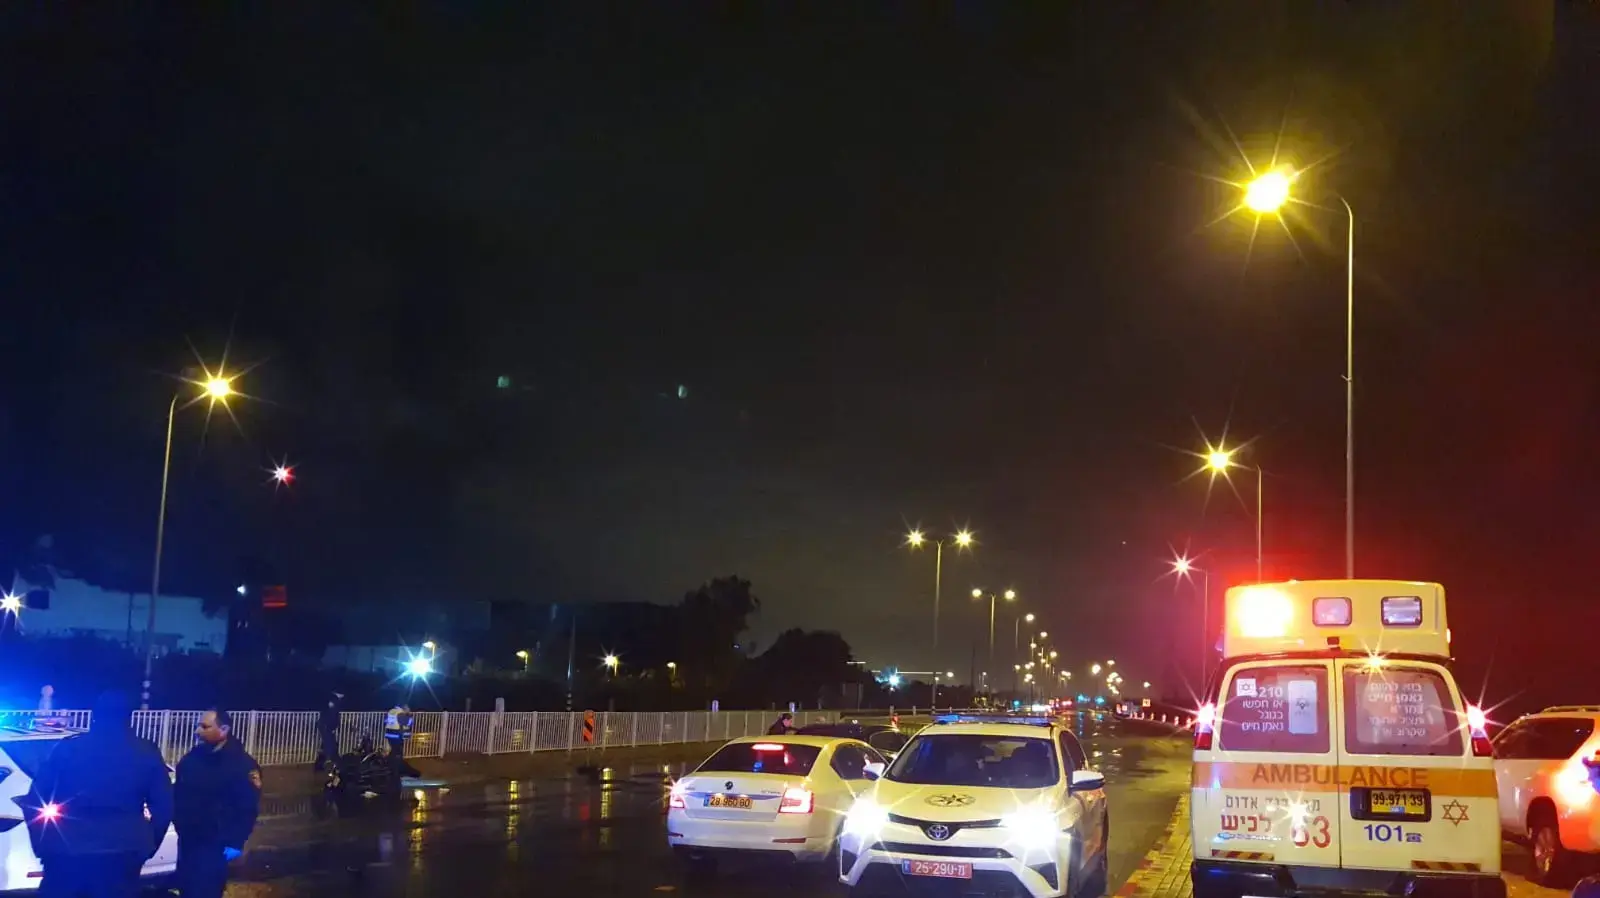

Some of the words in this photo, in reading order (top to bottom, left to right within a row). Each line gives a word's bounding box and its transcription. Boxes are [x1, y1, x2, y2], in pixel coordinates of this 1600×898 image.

[1242, 699, 1269, 709] חפשו
[1272, 699, 1283, 708] או
[1257, 709, 1284, 719] בגוגל
[1241, 721, 1260, 731] חיים
[1262, 721, 1284, 732] נאמן
[1251, 763, 1430, 787] AMBULANCE
[1225, 795, 1258, 809] אדום
[1220, 813, 1272, 833] לכיש
[1363, 824, 1403, 842] 101
